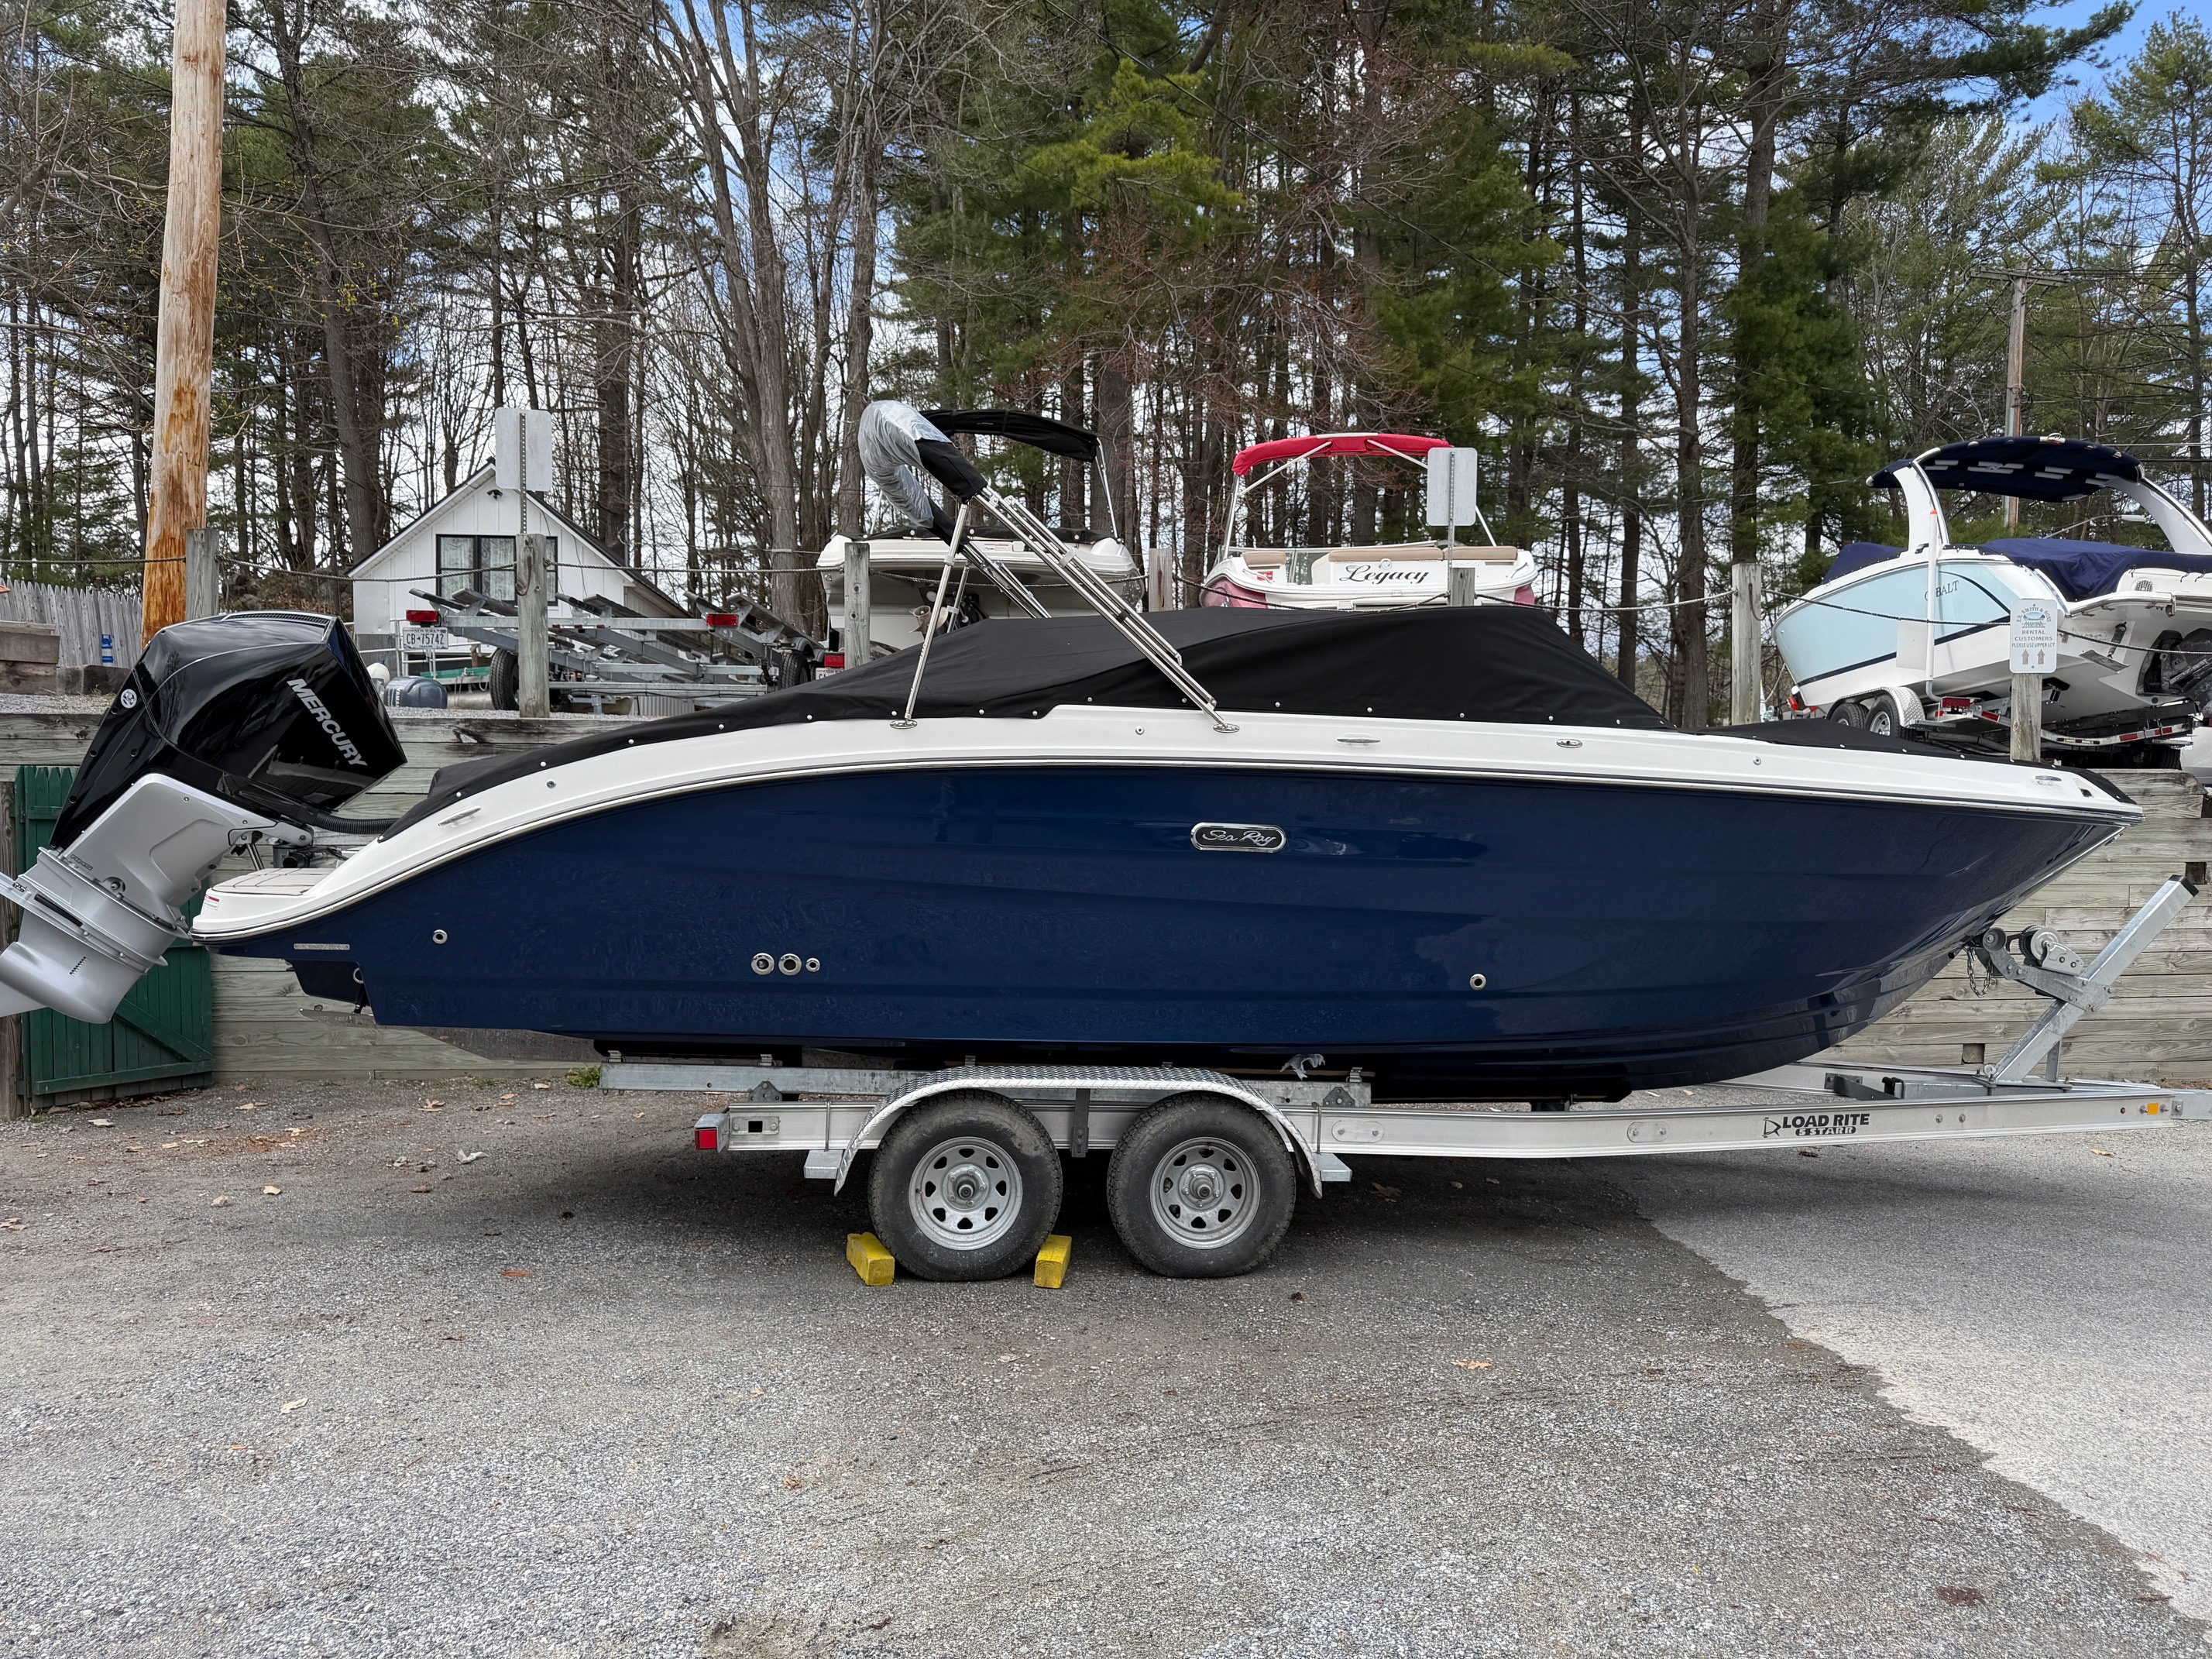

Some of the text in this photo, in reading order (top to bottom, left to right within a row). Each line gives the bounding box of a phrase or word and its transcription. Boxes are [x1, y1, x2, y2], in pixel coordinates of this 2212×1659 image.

[1339, 565, 1429, 585] Legacy
[1924, 579, 1960, 601] CBALT
[420, 633, 445, 644] 75742
[287, 678, 368, 766] MERCURY
[1202, 830, 1276, 847] Sea Ray
[1782, 1113, 1870, 1129] LOAD RITE
[1809, 1126, 1854, 1135] STARR
